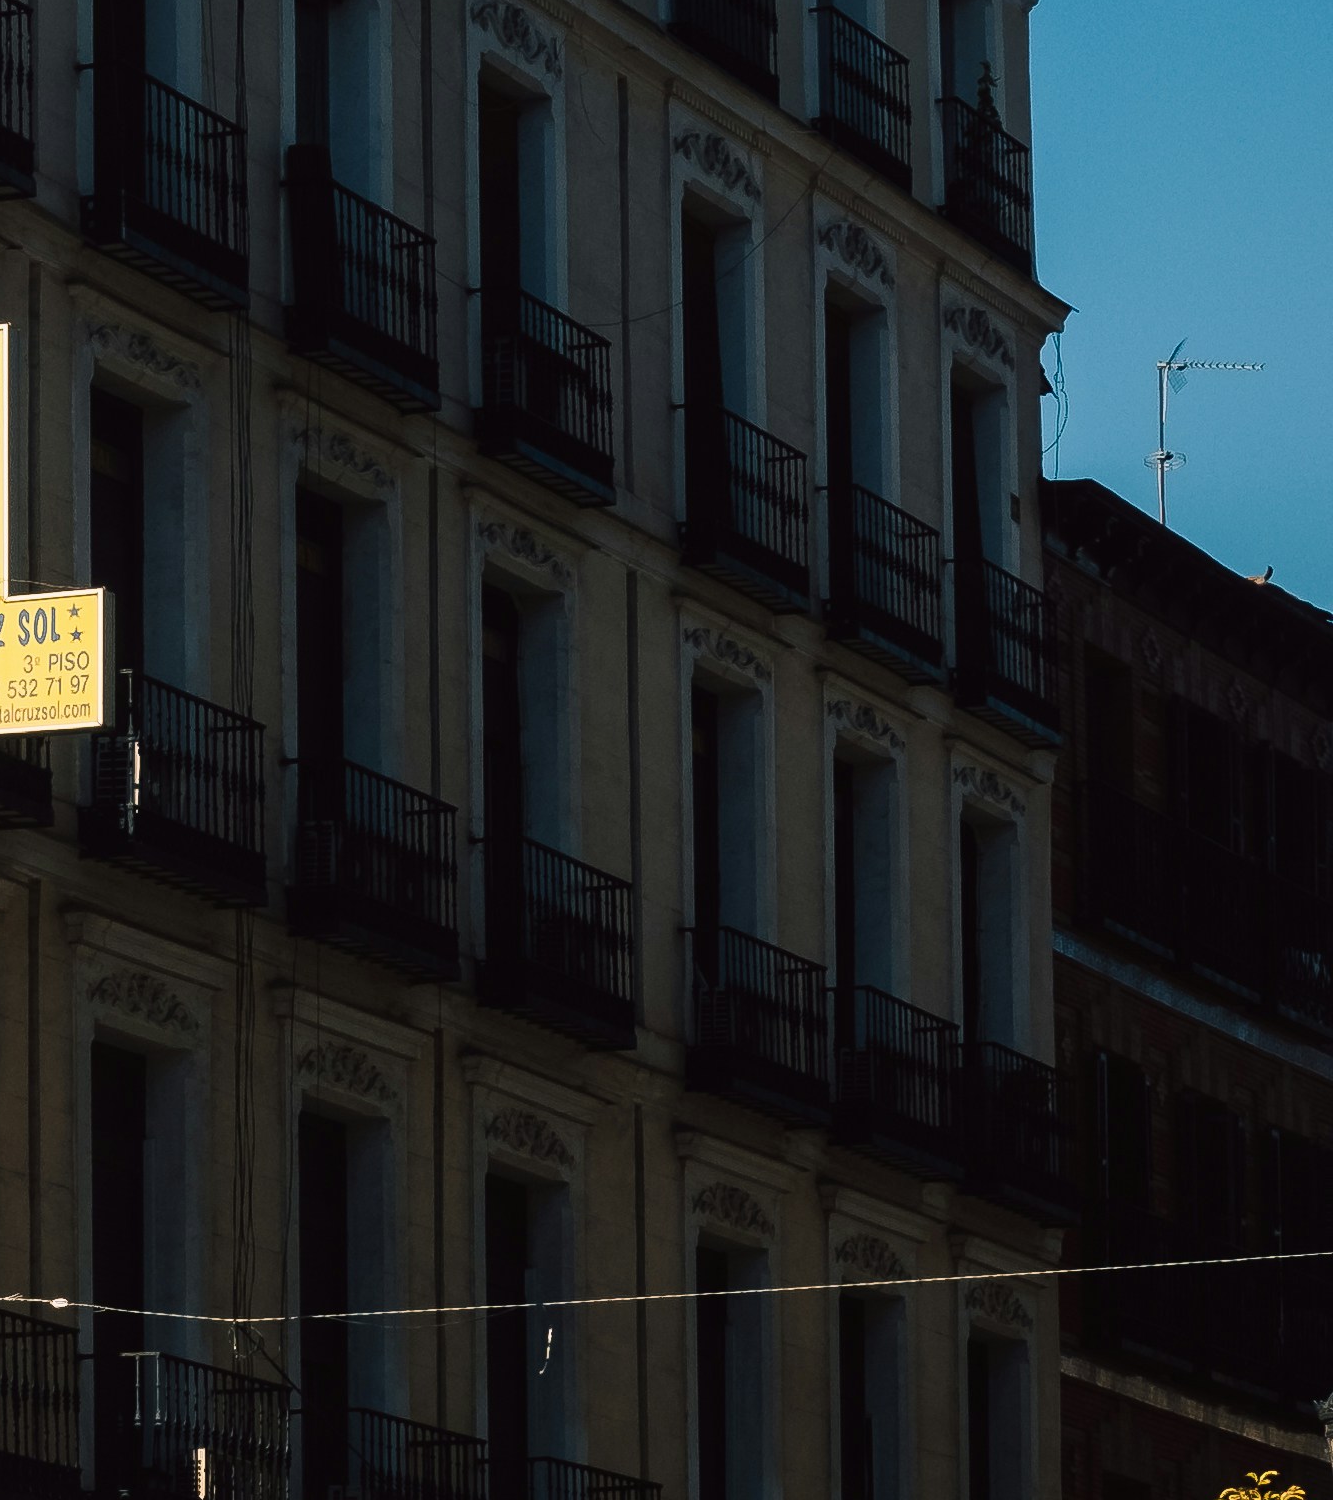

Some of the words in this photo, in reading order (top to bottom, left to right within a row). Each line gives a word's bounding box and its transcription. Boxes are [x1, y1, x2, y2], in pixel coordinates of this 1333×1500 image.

[18, 607, 61, 647] SOL
[48, 652, 90, 672] PISO
[7, 680, 37, 698] 532
[45, 677, 64, 696] 71
[70, 675, 90, 694] 97
